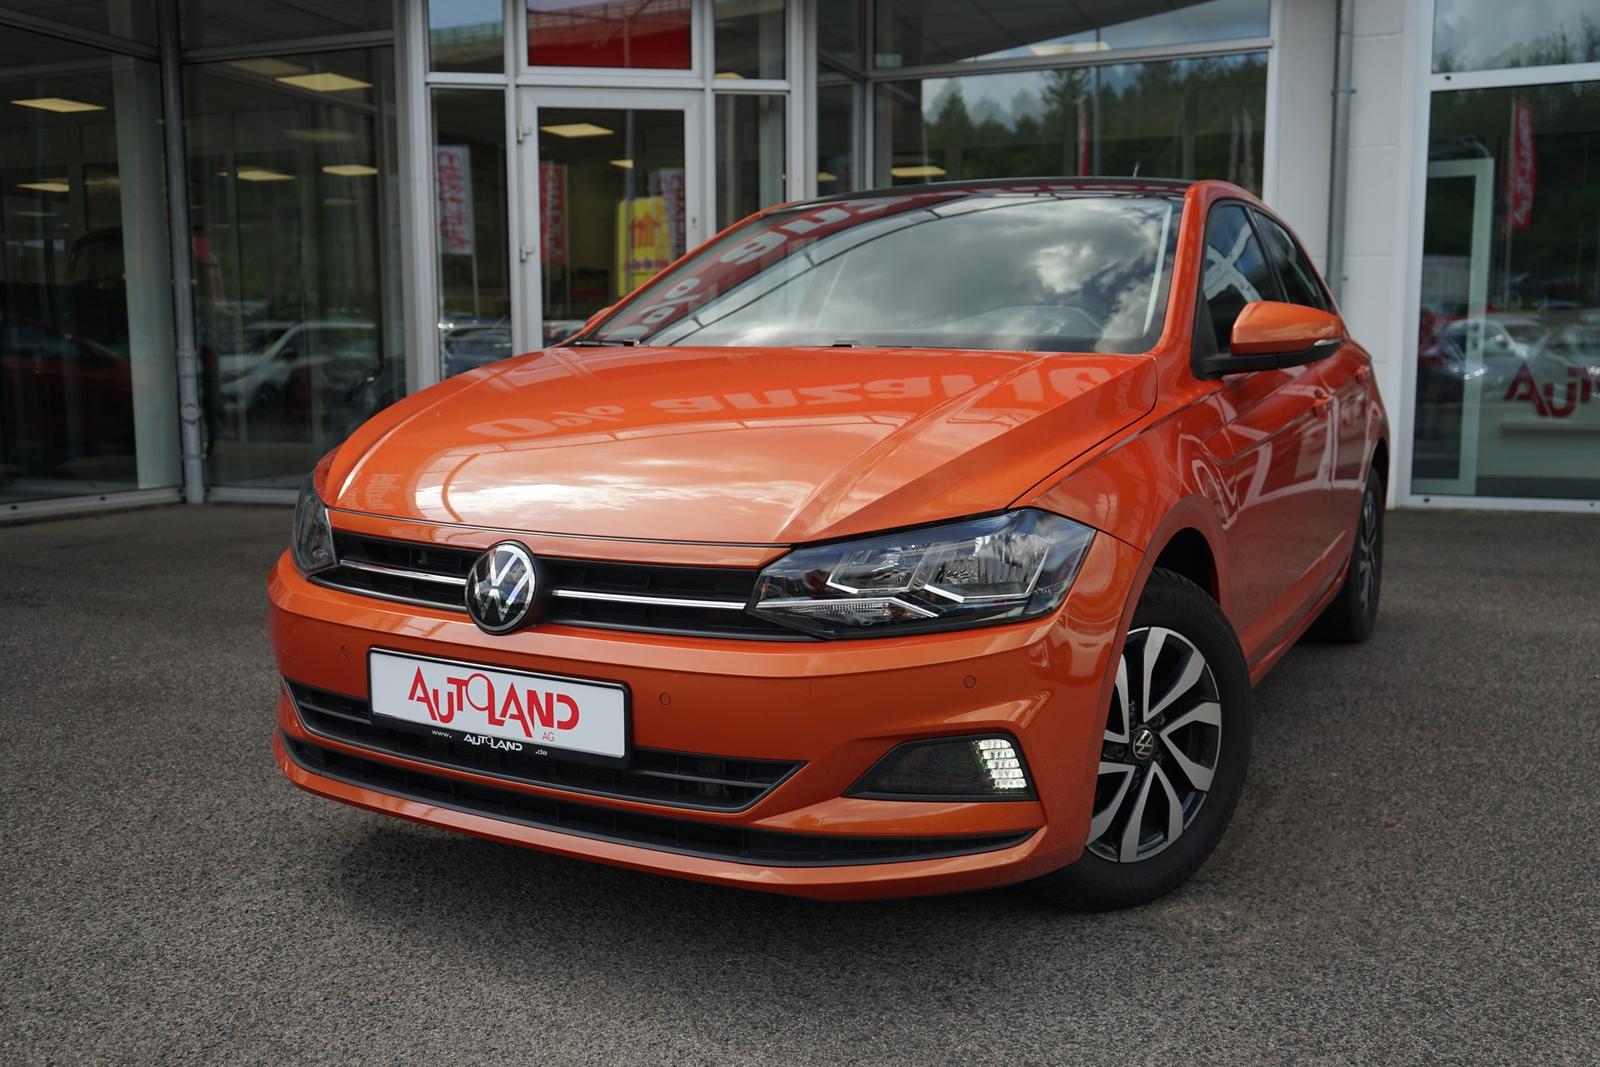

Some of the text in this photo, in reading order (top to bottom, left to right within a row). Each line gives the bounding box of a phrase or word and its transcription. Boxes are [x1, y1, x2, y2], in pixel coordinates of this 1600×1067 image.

[1503, 360, 1600, 418] AUT
[408, 667, 580, 738] AUTOLAND
[464, 734, 523, 752] AUTOLAND
[542, 731, 555, 742] AG
